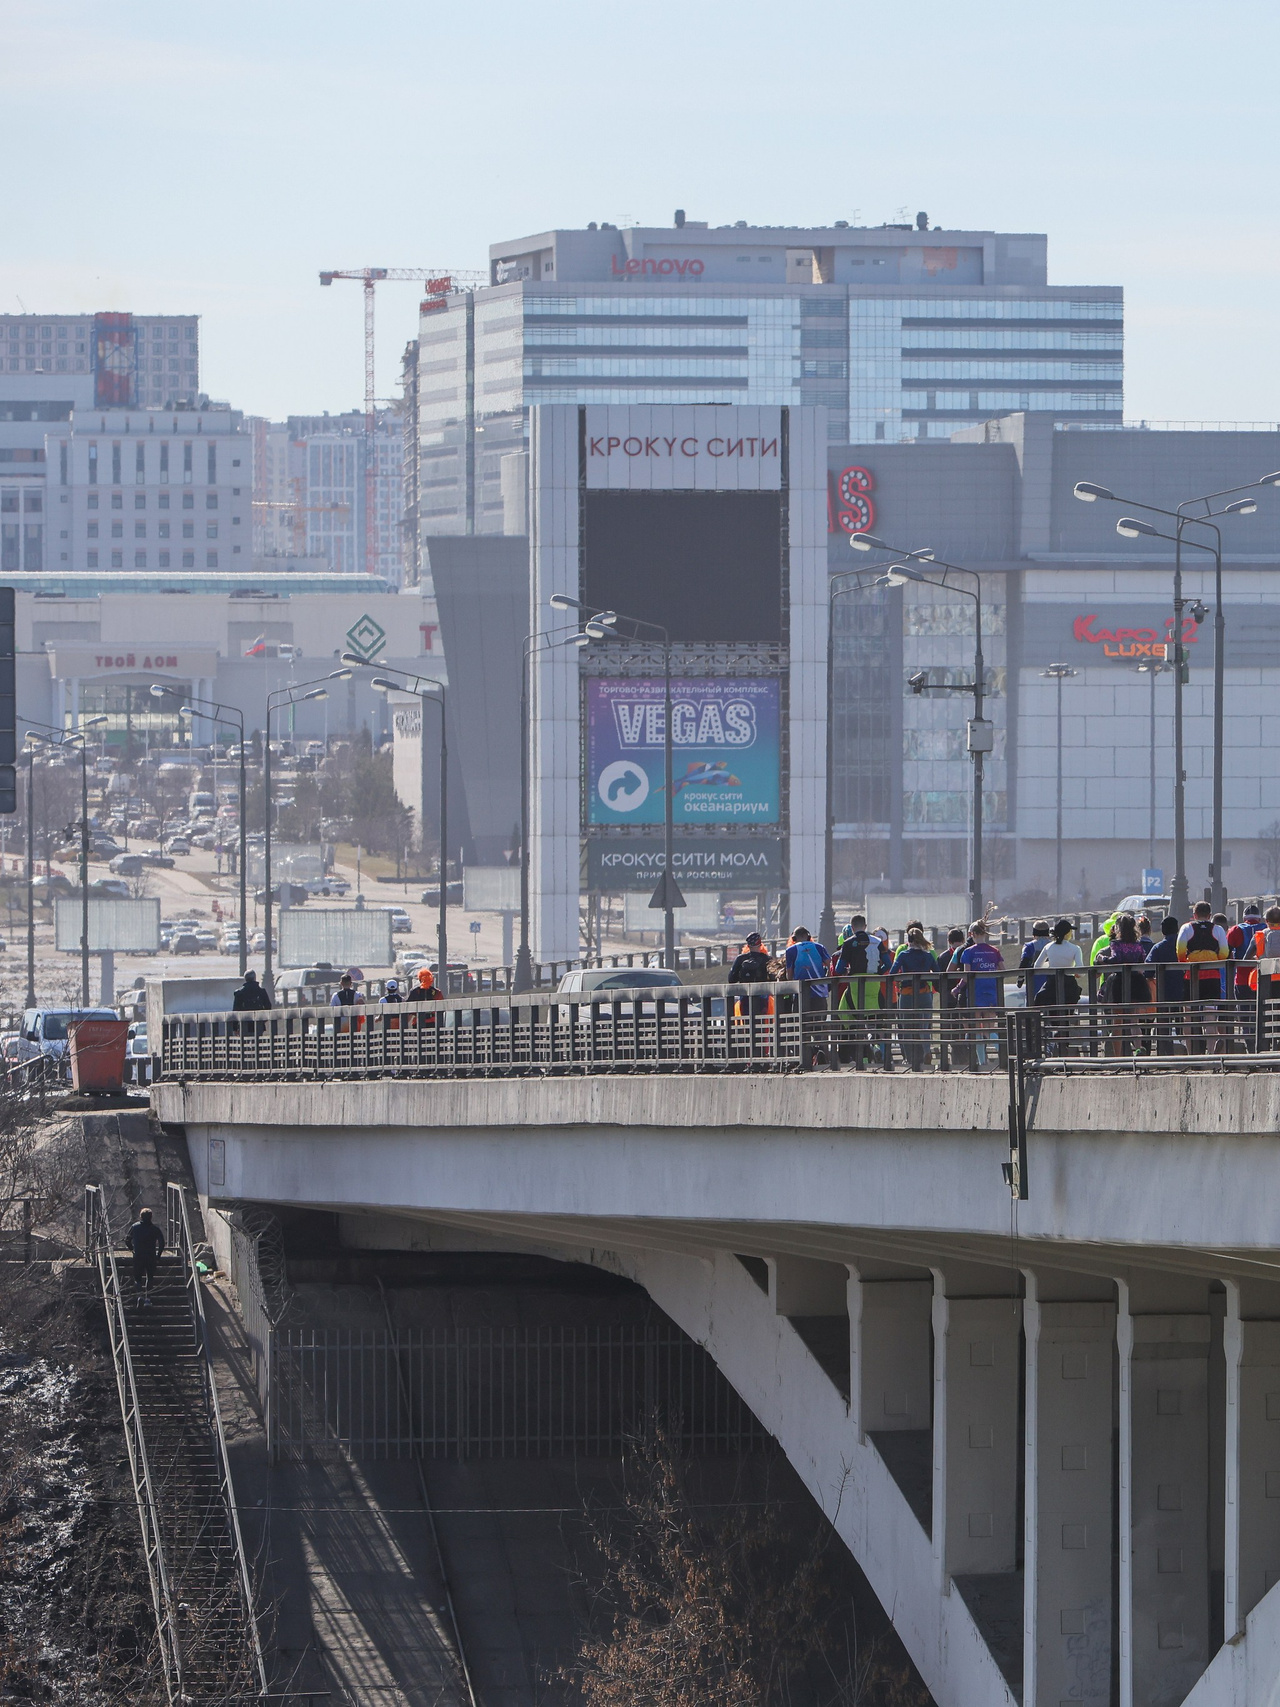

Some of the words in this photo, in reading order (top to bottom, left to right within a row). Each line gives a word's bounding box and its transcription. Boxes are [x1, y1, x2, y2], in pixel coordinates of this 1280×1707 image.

[611, 254, 705, 275] Lenovo
[590, 437, 699, 457] КРОКУС
[707, 437, 778, 457] СИТИ
[827, 466, 873, 534] S
[1164, 617, 1199, 643] 22
[1104, 643, 1166, 657] LUXE
[95, 653, 136, 668] ТВОЙ
[143, 656, 178, 669] ДОМ
[599, 685, 722, 695] ТОРГОВО-РАЗВЛКАТЕЛЬНЫЙ
[724, 686, 769, 694] КОМПЛЕКС
[617, 703, 751, 744] VEGAS
[684, 792, 718, 802] крокус
[719, 792, 743, 800] сити
[684, 802, 769, 814] океанариум
[601, 853, 667, 866] КРОКУС
[671, 853, 716, 866] СИТИ
[720, 853, 769, 866] МОЛЛ
[686, 871, 733, 879] РОСКОШИ
[1147, 876, 1161, 887] P2
